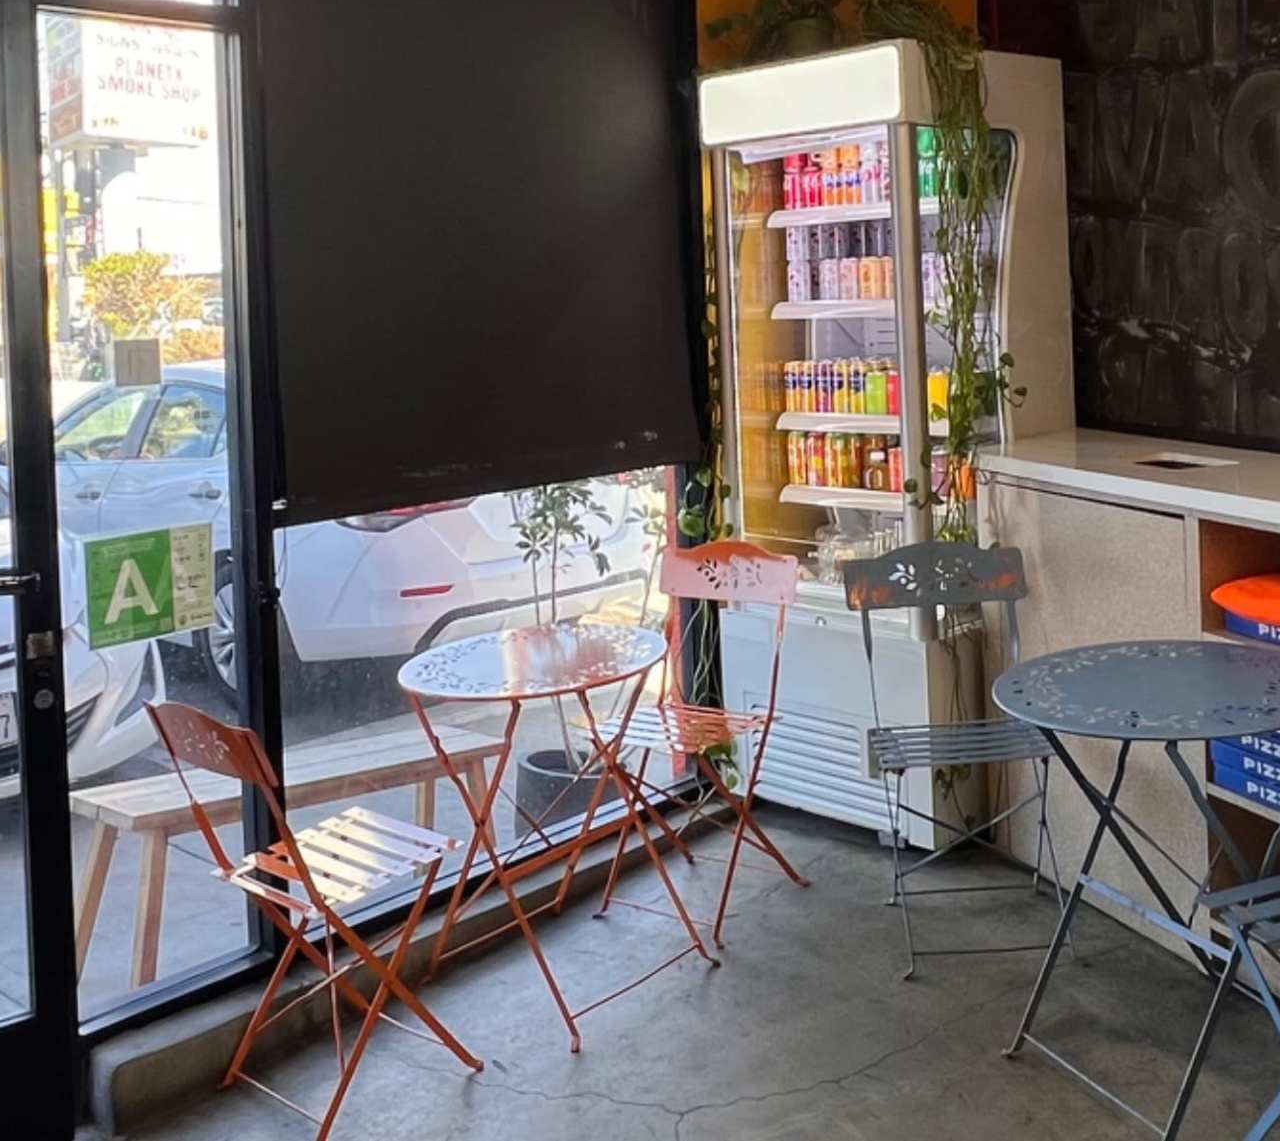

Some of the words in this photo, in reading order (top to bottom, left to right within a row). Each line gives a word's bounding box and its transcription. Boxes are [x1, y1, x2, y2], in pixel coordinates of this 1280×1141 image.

[98, 74, 156, 98] SMOKE
[162, 84, 201, 103] SHOP
[104, 558, 159, 625] A
